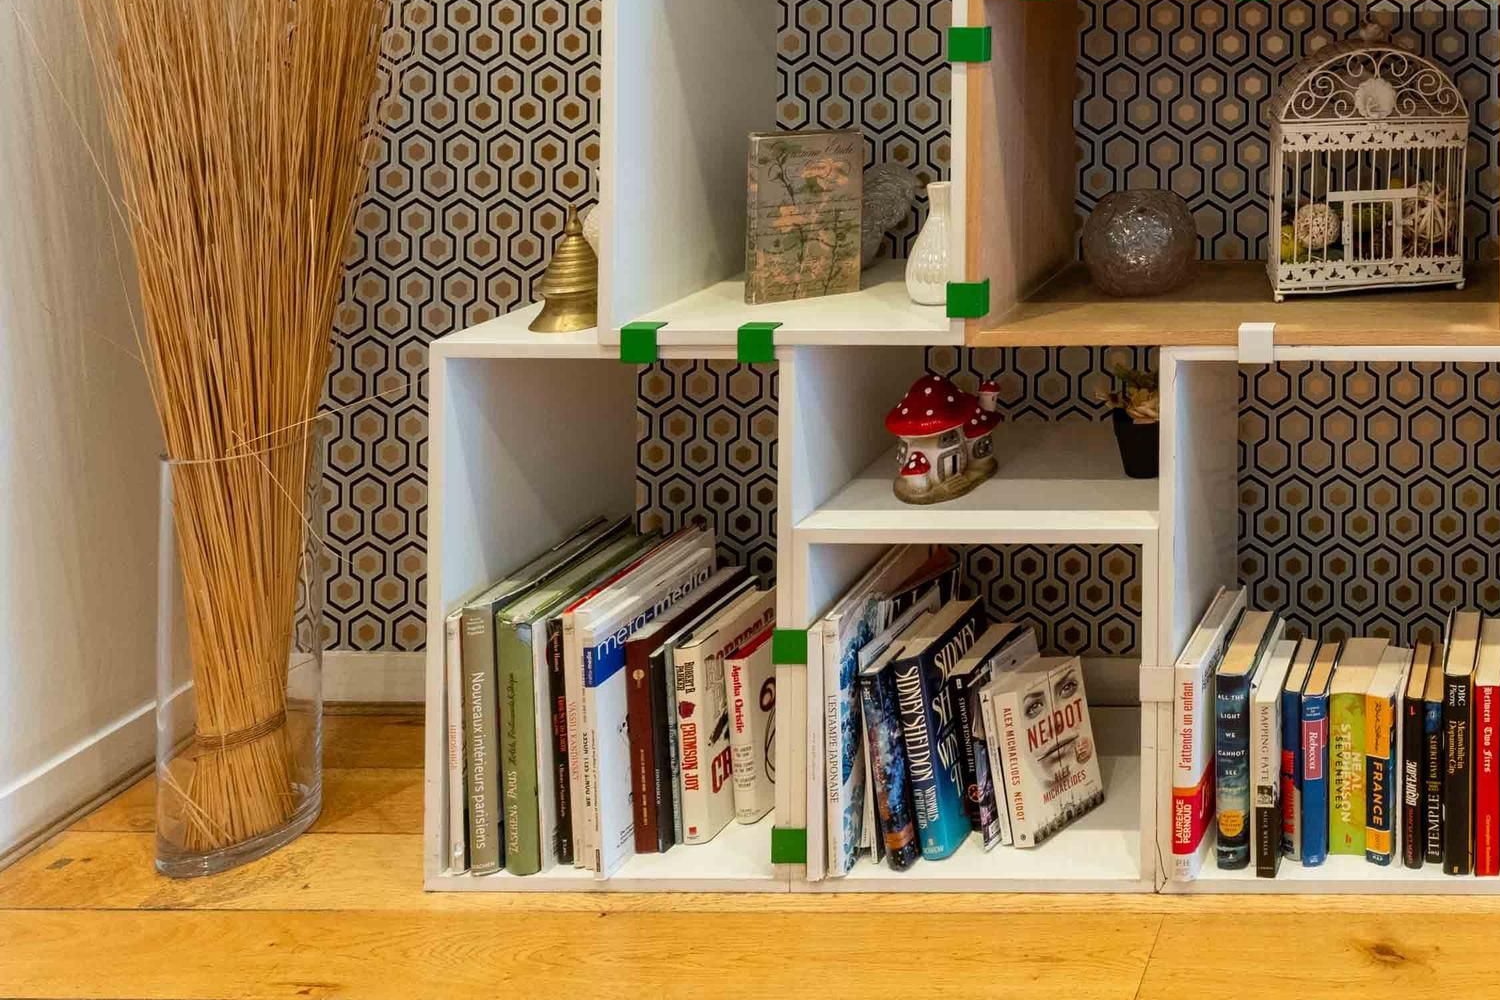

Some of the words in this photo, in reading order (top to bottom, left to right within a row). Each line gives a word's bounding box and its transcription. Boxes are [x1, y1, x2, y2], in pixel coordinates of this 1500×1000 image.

[598, 565, 712, 661] meta-media
[676, 665, 685, 692] PARKER
[684, 661, 695, 688] ROBERT
[731, 664, 742, 697] Agatha
[896, 666, 925, 715] SIDNEY
[471, 672, 486, 733] Nouveaux
[958, 697, 967, 722] GAMES
[1181, 682, 1193, 711] enfant
[1449, 684, 1457, 707] Pierre
[1457, 685, 1466, 706] DBC
[1483, 687, 1492, 723] Between
[568, 702, 577, 732] VASSILI
[734, 699, 745, 734] Christie
[827, 695, 838, 747] L'ESTAMPE
[1002, 707, 1012, 728] ALEX
[1027, 698, 1083, 753] NEIDOT
[1183, 714, 1192, 726] un
[1259, 706, 1270, 753] MAPPING
[680, 722, 698, 770] CRIMSON
[903, 714, 934, 781] SHELDON
[962, 723, 974, 756] HUNGER
[1178, 727, 1192, 771] J'attends
[1217, 749, 1246, 757] CANNOT
[1308, 731, 1318, 770] Rebecca
[1430, 735, 1438, 760] DEBTS
[1448, 720, 1457, 758] Dopamine
[1457, 721, 1466, 760] Meanwhile
[1483, 727, 1493, 746] Two
[473, 735, 488, 792] intérieurs
[569, 733, 580, 782] KANDINSKY
[967, 757, 976, 773] THE
[1005, 729, 1020, 786] MICHAELIDES
[1260, 756, 1270, 782] FATE
[1335, 736, 1343, 809] SEVENEVES
[1341, 724, 1352, 822] STEPHENSON
[1351, 752, 1362, 791] NEAL
[1430, 761, 1438, 778] BAD
[1447, 759, 1457, 775] City
[1457, 761, 1466, 769] in
[1483, 749, 1493, 773] Fires
[685, 773, 699, 792] JOY
[827, 749, 840, 803] JAPONAISE
[1043, 769, 1087, 804] MICHAELIDES
[1372, 762, 1383, 826] FRANCE
[472, 795, 489, 848] parisiens
[1013, 792, 1025, 822] NEIDOT
[1175, 799, 1184, 844] LAURENCE
[1183, 804, 1192, 844] PERNOUD
[1428, 794, 1439, 850] TEMPLE
